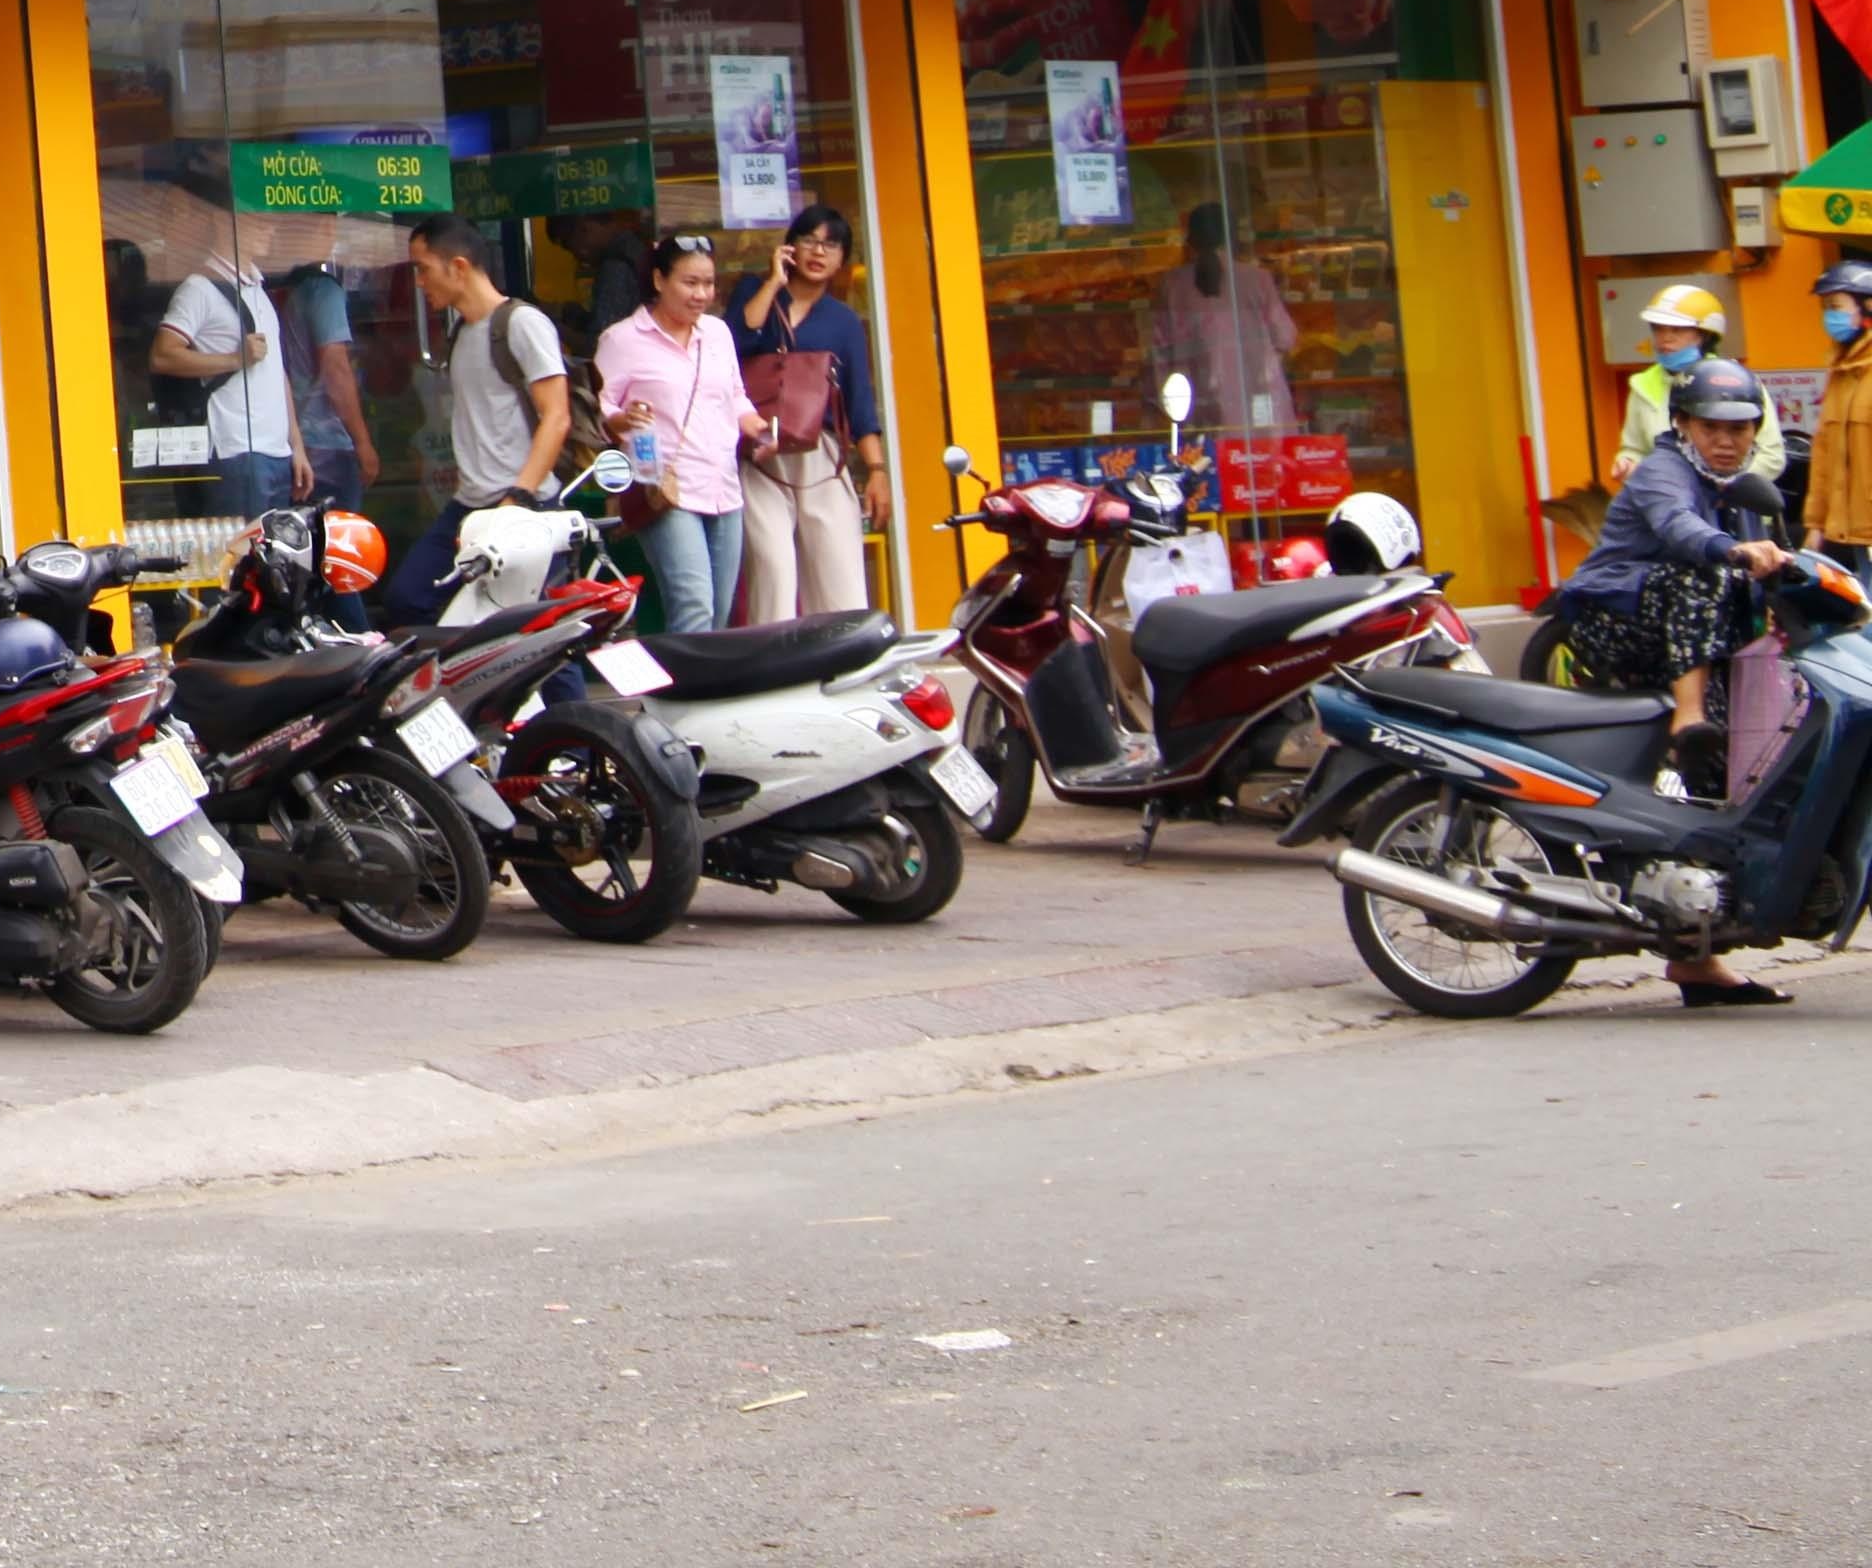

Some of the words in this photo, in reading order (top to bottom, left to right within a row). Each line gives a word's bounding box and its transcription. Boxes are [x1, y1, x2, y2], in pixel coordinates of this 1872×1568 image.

[263, 152, 286, 178] MỞ
[289, 150, 323, 178] CỬA:
[376, 155, 421, 178] 06:30
[264, 181, 307, 206] ĐÓNG
[309, 181, 343, 206] CỬA:
[379, 184, 424, 205] 21:30
